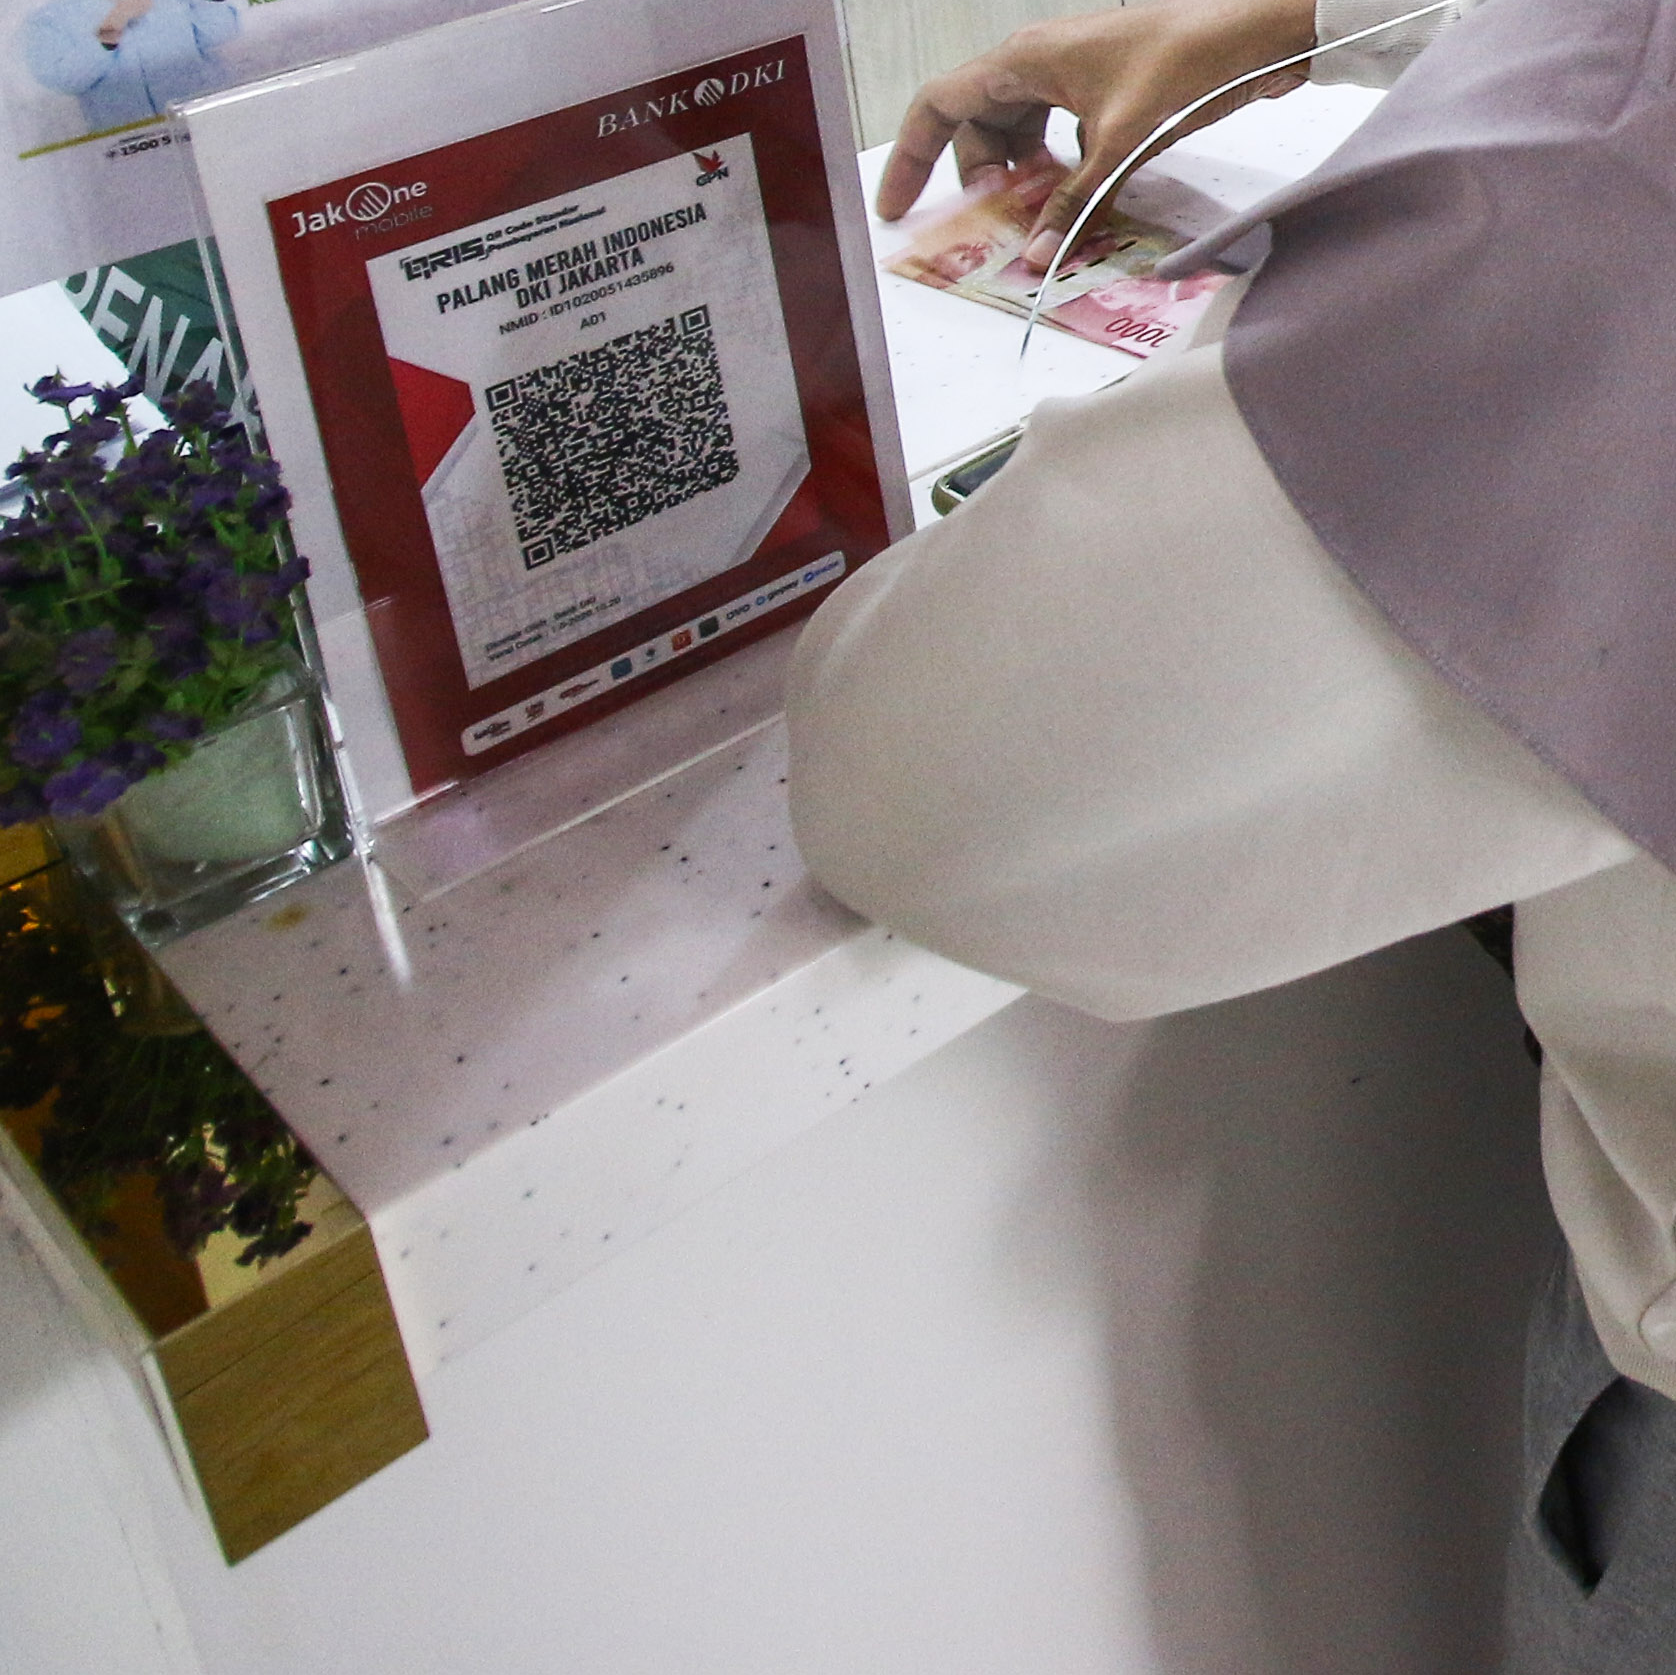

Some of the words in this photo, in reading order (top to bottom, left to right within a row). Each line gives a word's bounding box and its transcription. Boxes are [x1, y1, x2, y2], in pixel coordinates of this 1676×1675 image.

[597, 89, 690, 138] BANK
[730, 59, 786, 97] DKI
[696, 166, 729, 187] GPN
[291, 181, 429, 239] JakOne
[355, 202, 433, 240] mobile
[401, 236, 488, 282] QRIS
[437, 266, 520, 314] PALANG
[525, 238, 597, 283] MERAH
[603, 202, 707, 255] INDONESIA
[516, 282, 552, 310] DKI
[558, 245, 645, 295] JAKARTA
[499, 310, 539, 336] NMID
[550, 261, 675, 319] ID1020051435896
[580, 310, 607, 331] A01
